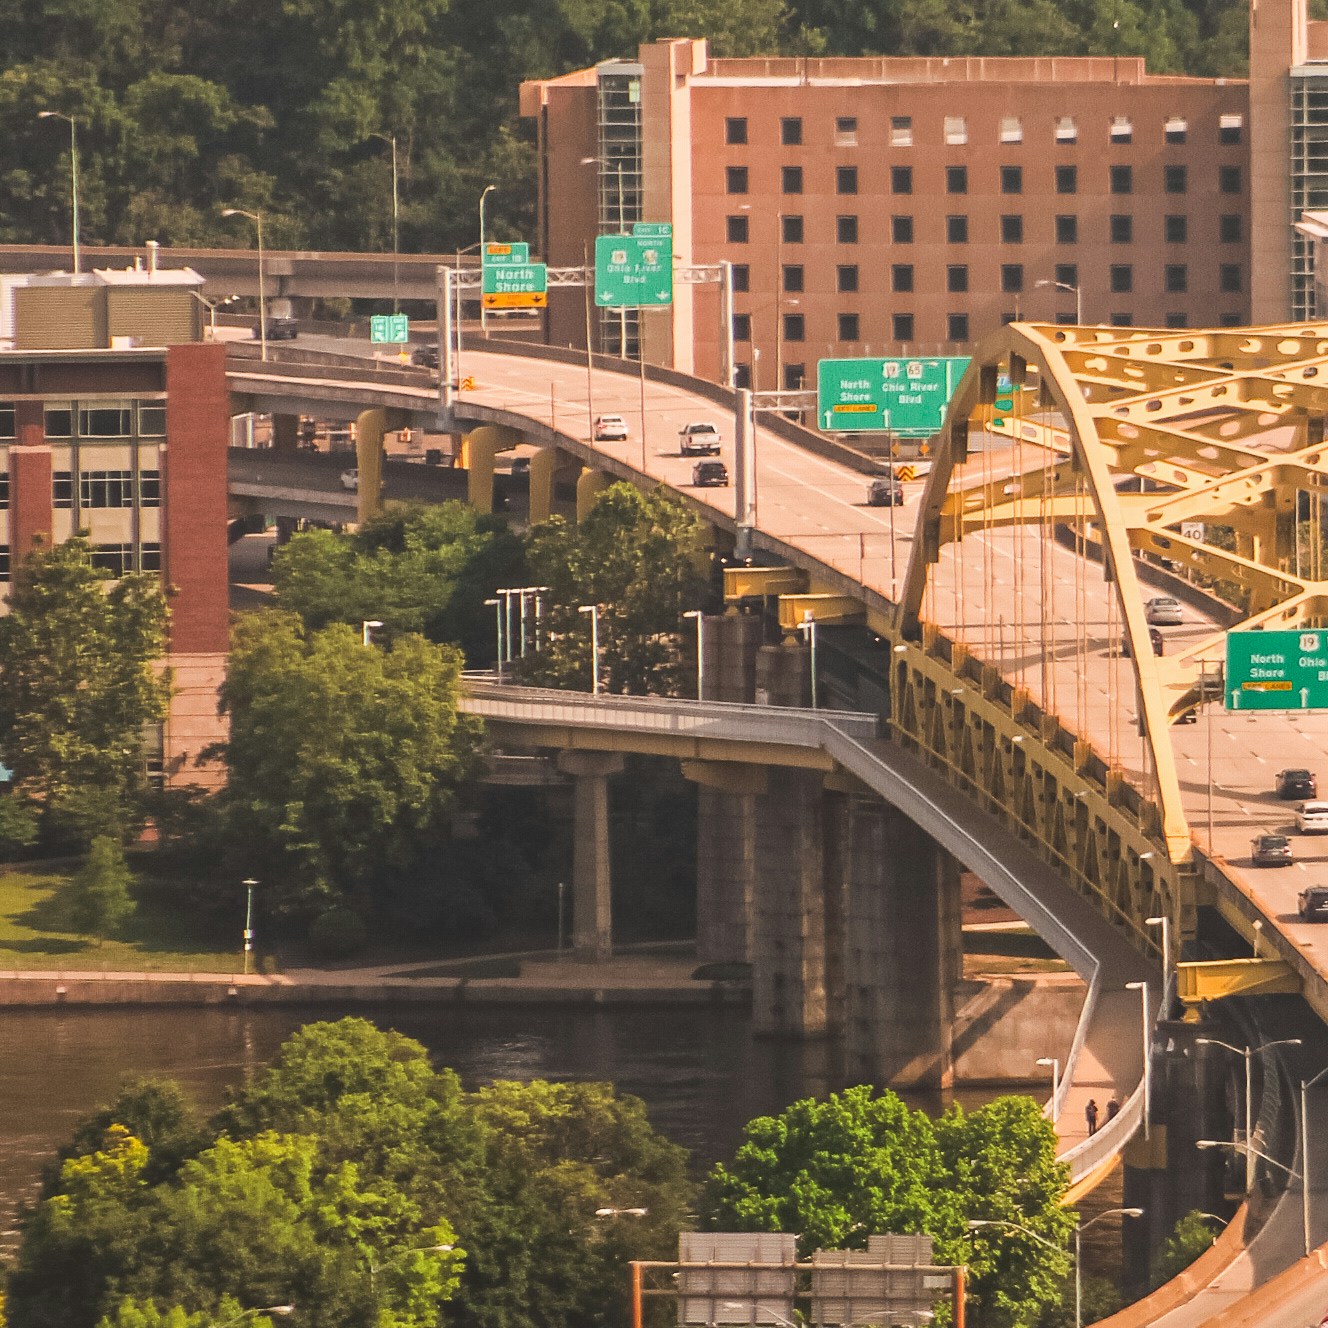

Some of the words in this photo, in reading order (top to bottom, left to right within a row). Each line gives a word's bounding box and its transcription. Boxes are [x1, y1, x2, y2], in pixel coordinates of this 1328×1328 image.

[495, 269, 534, 280] North
[495, 282, 535, 293] Shore
[840, 379, 871, 390] North
[882, 382, 906, 392] Ohio
[909, 382, 938, 392] River
[840, 392, 871, 402] Shore
[898, 394, 922, 404] Blvd
[1184, 530, 1200, 540] 40
[1303, 638, 1315, 647] 19
[1250, 654, 1285, 664] North
[1299, 657, 1326, 667] Ohio
[1250, 667, 1285, 678] Shore
